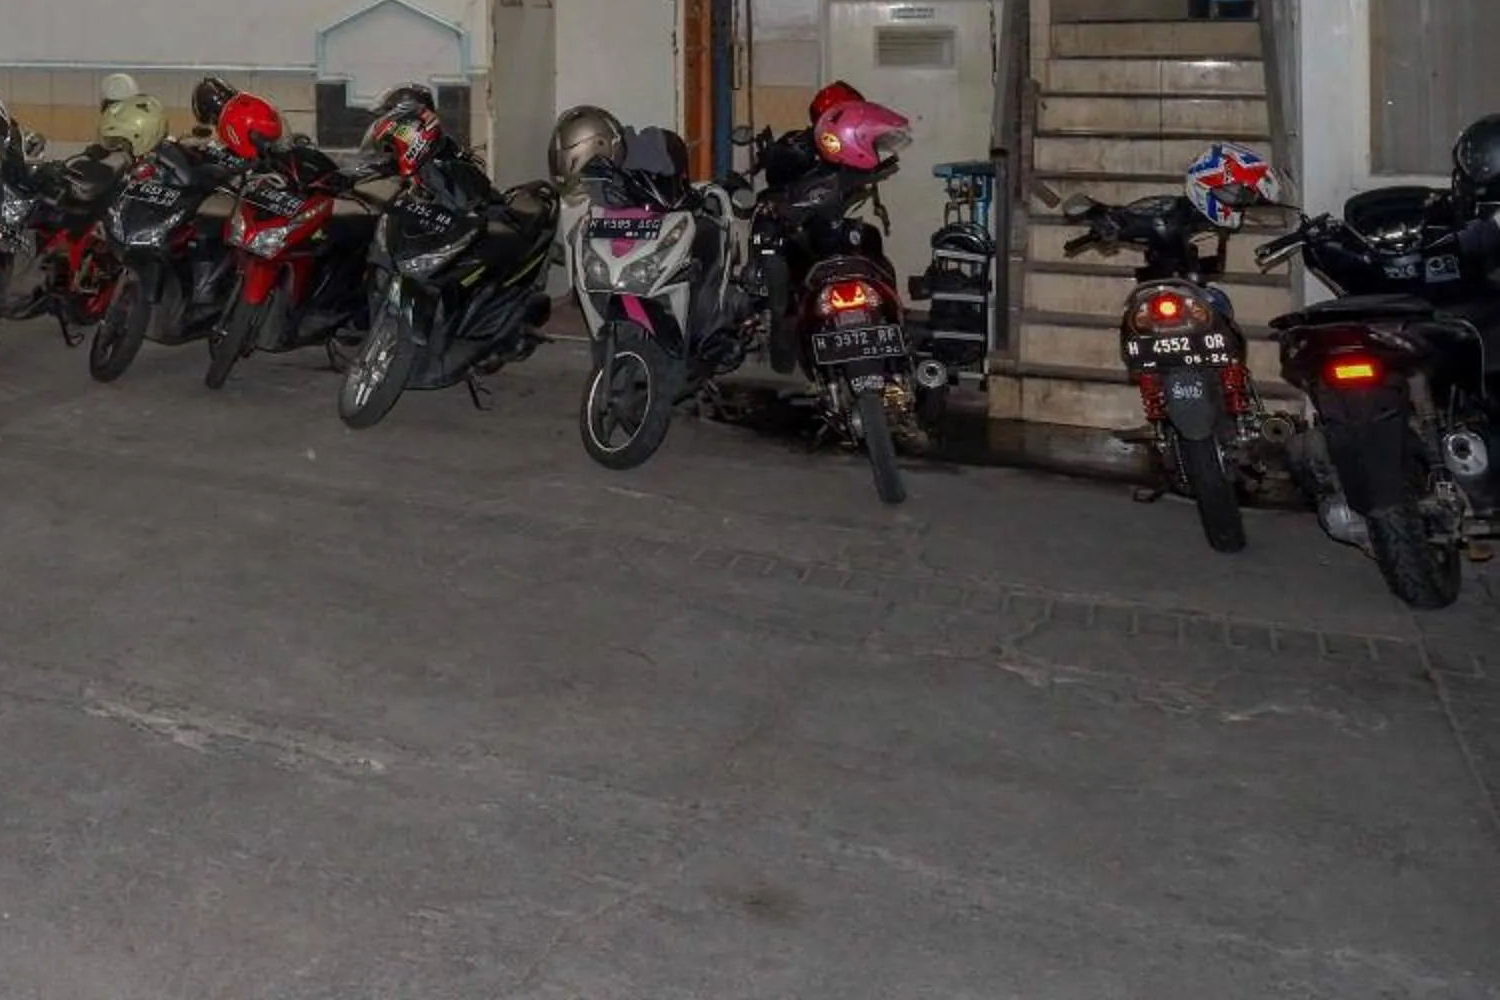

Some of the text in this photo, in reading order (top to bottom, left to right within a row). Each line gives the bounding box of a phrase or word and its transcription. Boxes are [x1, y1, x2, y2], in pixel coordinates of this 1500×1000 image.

[817, 337, 826, 350] H
[1127, 341, 1140, 356] H
[1153, 337, 1191, 353] 4552
